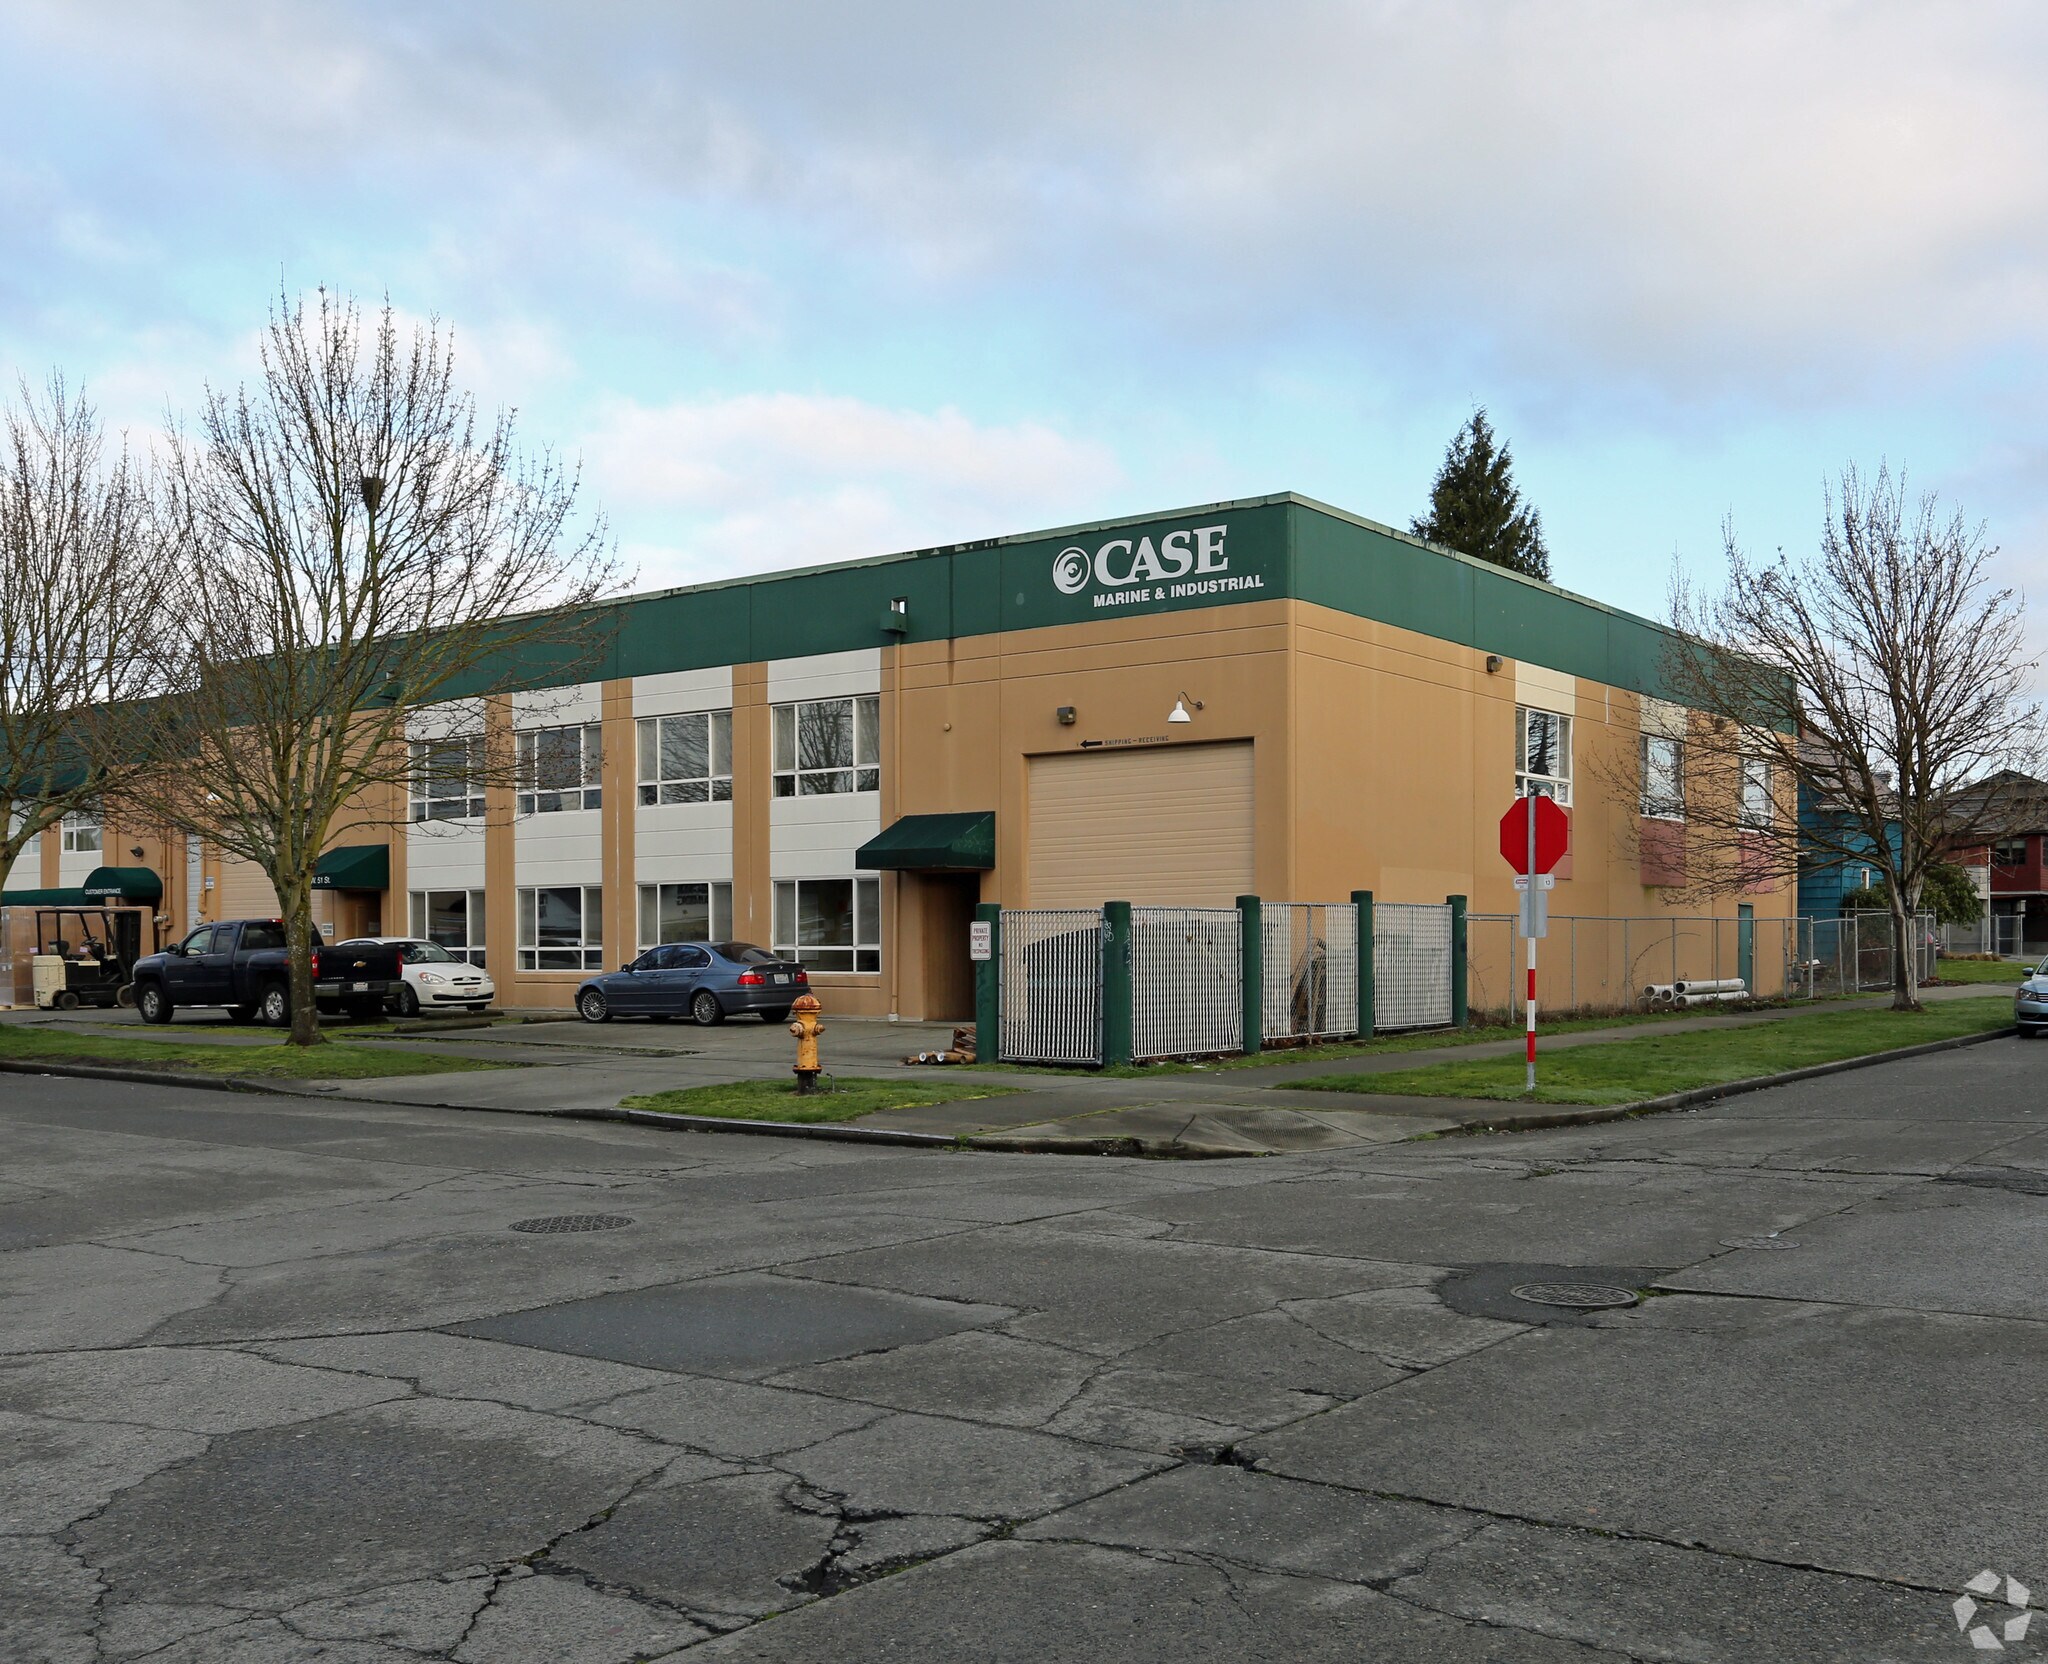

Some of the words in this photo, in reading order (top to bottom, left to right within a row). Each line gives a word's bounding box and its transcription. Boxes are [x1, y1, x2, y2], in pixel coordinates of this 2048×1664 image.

[1094, 524, 1229, 587] CASE
[1093, 588, 1150, 608] MARINE
[1154, 586, 1166, 600] &
[1170, 574, 1265, 598] INDUSTRIAL
[1104, 738, 1132, 746] SHIPPING
[1138, 735, 1169, 743] RECEIVING
[973, 927, 988, 935] PRIVATE
[972, 934, 989, 942] PROPERTY
